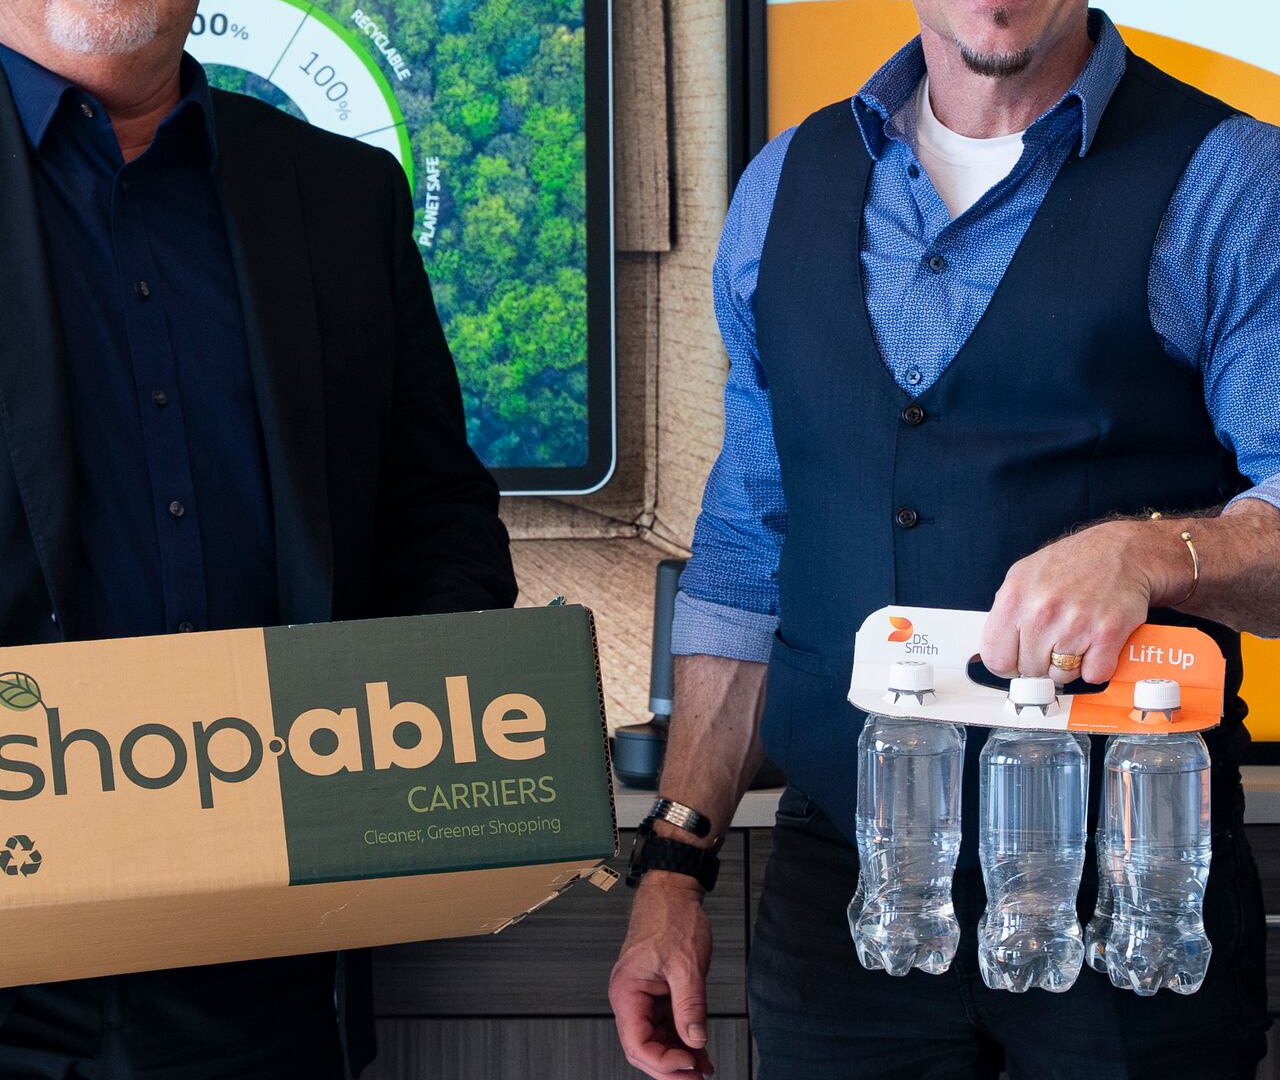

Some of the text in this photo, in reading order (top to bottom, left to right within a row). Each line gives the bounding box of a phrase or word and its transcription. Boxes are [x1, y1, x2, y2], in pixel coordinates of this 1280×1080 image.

[190, 13, 249, 41] 00%
[350, 8, 412, 81] RECYCLABLE
[298, 50, 352, 122] 100%
[419, 156, 441, 247] PLANET SAFE
[905, 642, 939, 655] Smith
[913, 634, 929, 645] DS
[1129, 645, 1195, 670] Lift Up
[407, 775, 557, 813] CARRIERS
[364, 816, 562, 846] Cleaner, Greener Shopping
